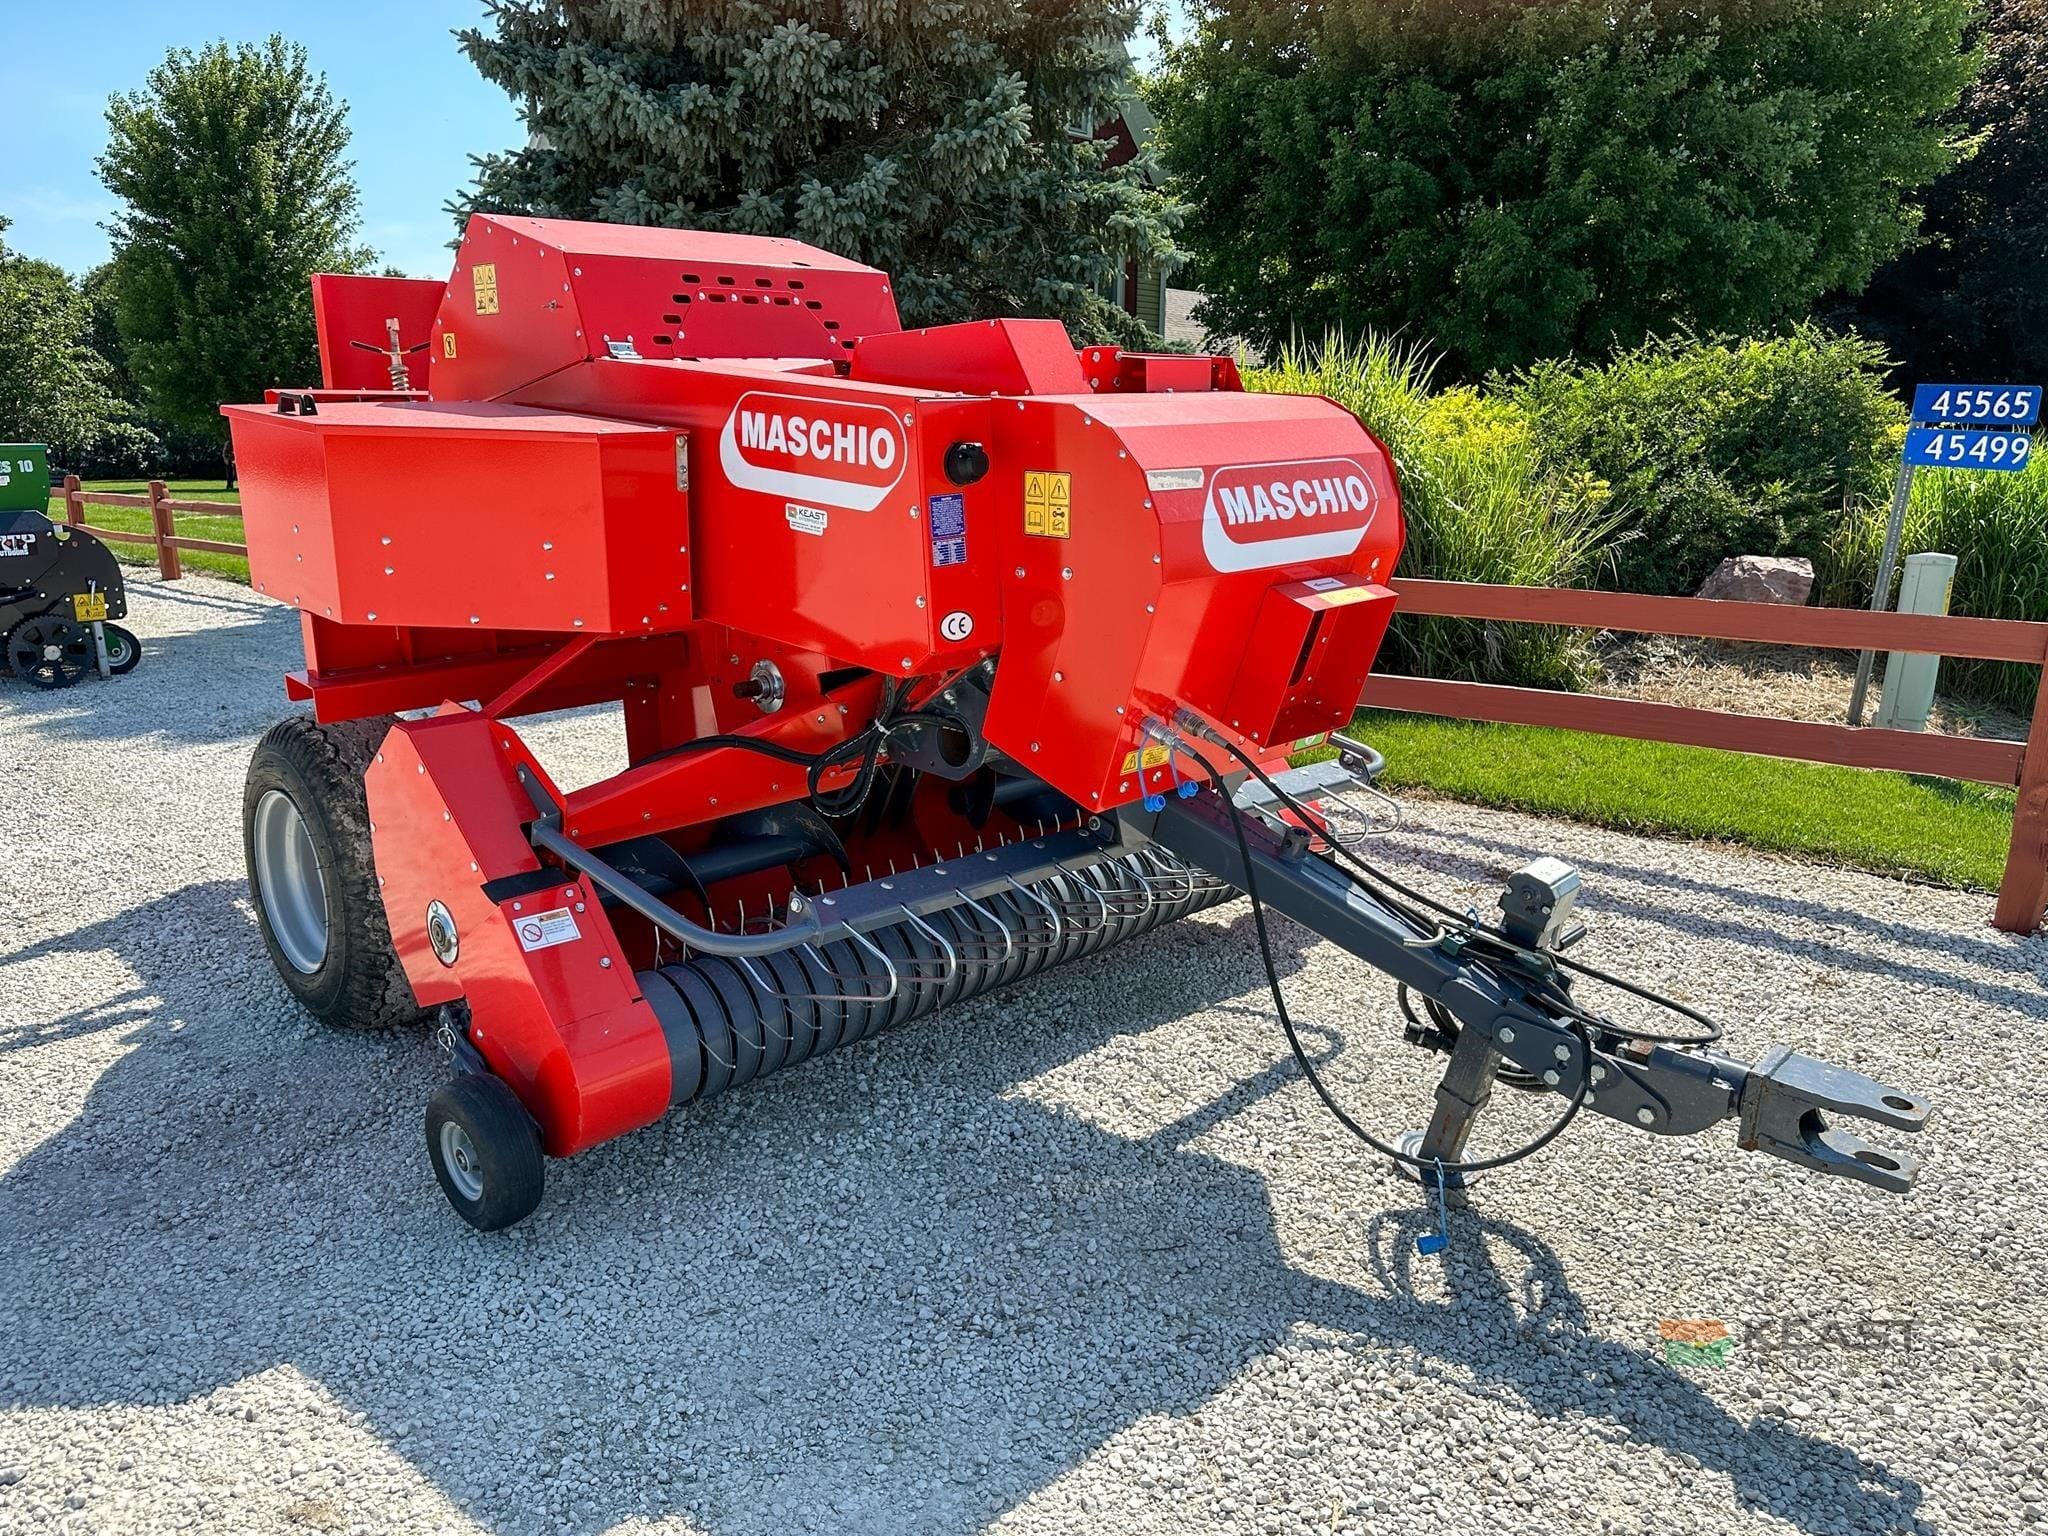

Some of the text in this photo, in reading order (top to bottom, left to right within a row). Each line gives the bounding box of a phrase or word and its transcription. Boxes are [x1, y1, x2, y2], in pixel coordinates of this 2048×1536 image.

[1932, 391, 2032, 418] 45565
[741, 410, 896, 470] MASCHIO
[1925, 434, 2029, 464] 45499
[17, 459, 34, 473] 10
[798, 507, 826, 521] KEAST
[1218, 475, 1369, 526] MASCHIO
[948, 616, 967, 636] CE
